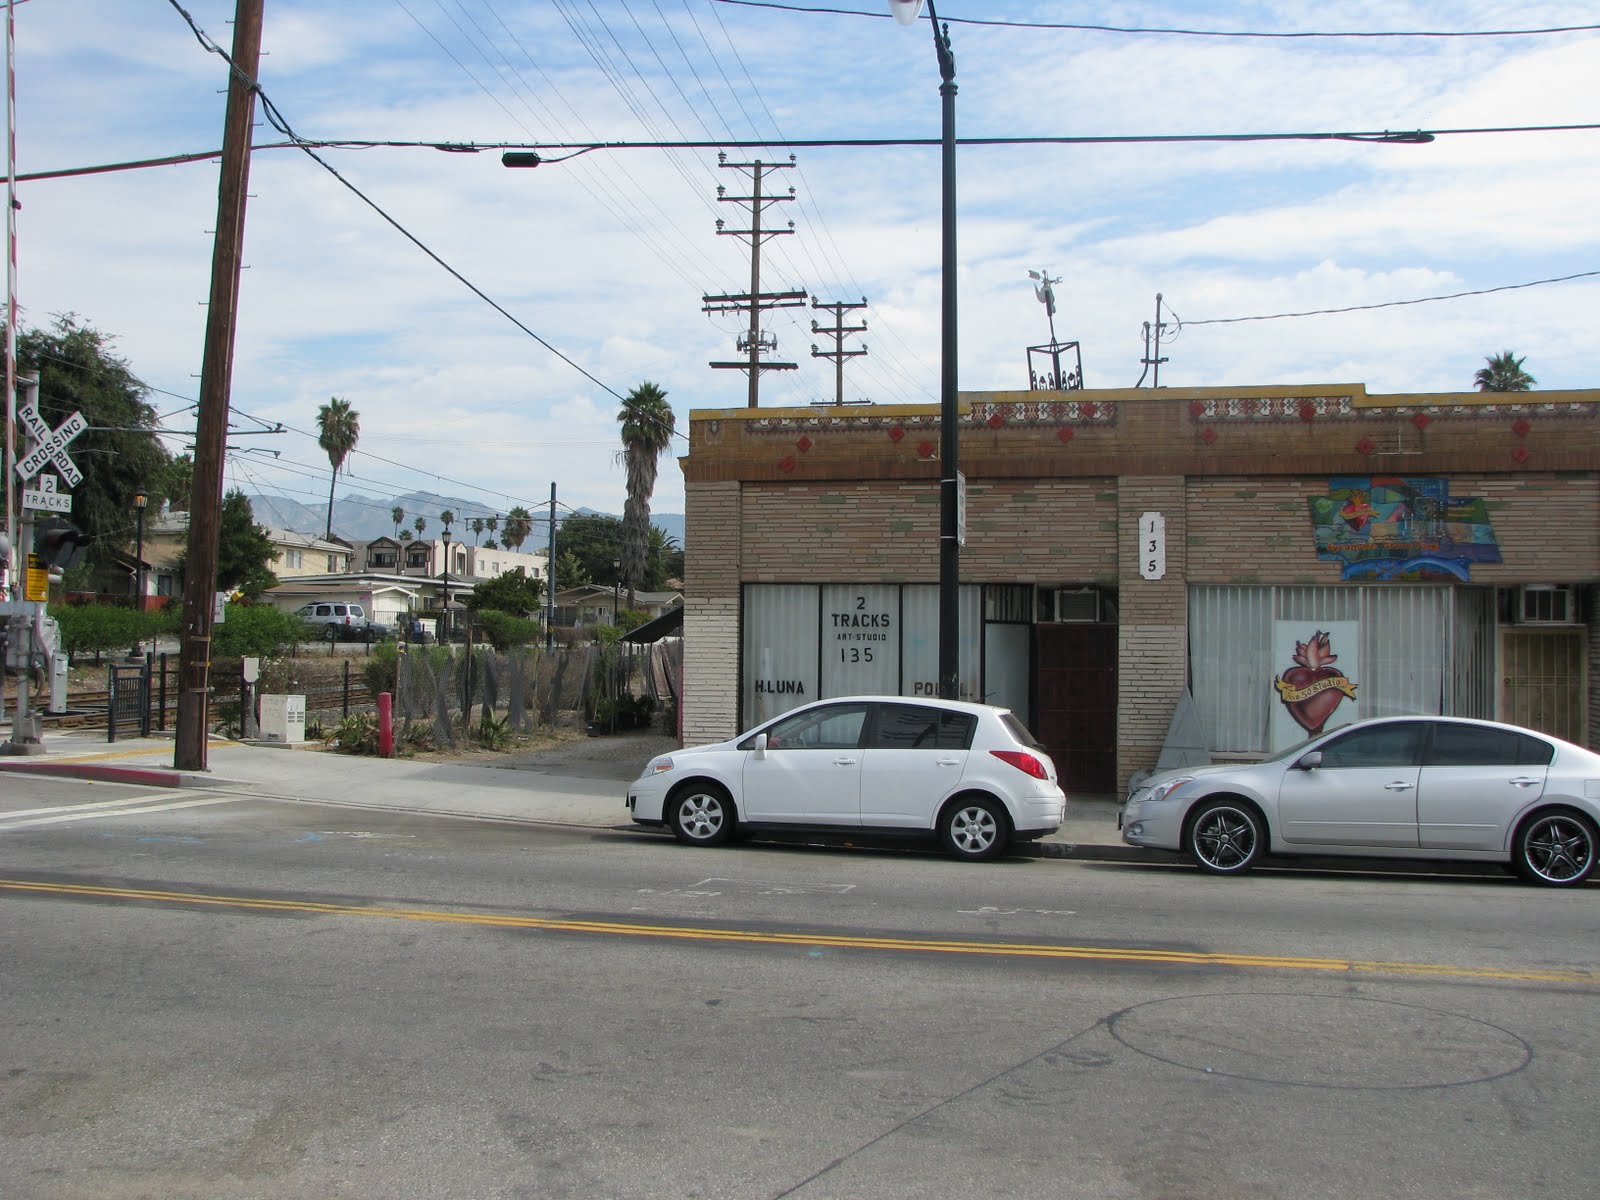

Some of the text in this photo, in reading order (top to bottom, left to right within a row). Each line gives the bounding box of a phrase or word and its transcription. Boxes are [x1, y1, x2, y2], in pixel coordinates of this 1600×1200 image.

[22, 406, 81, 486] RAIL ROAD
[23, 419, 81, 473] CROSSING
[45, 480, 54, 493] 2
[25, 494, 70, 508] TRACKS
[856, 596, 866, 610] 2
[831, 613, 890, 628] TRACKS
[841, 648, 873, 663] 135
[1302, 688, 1312, 699] 50
[1313, 679, 1341, 693] Studio
